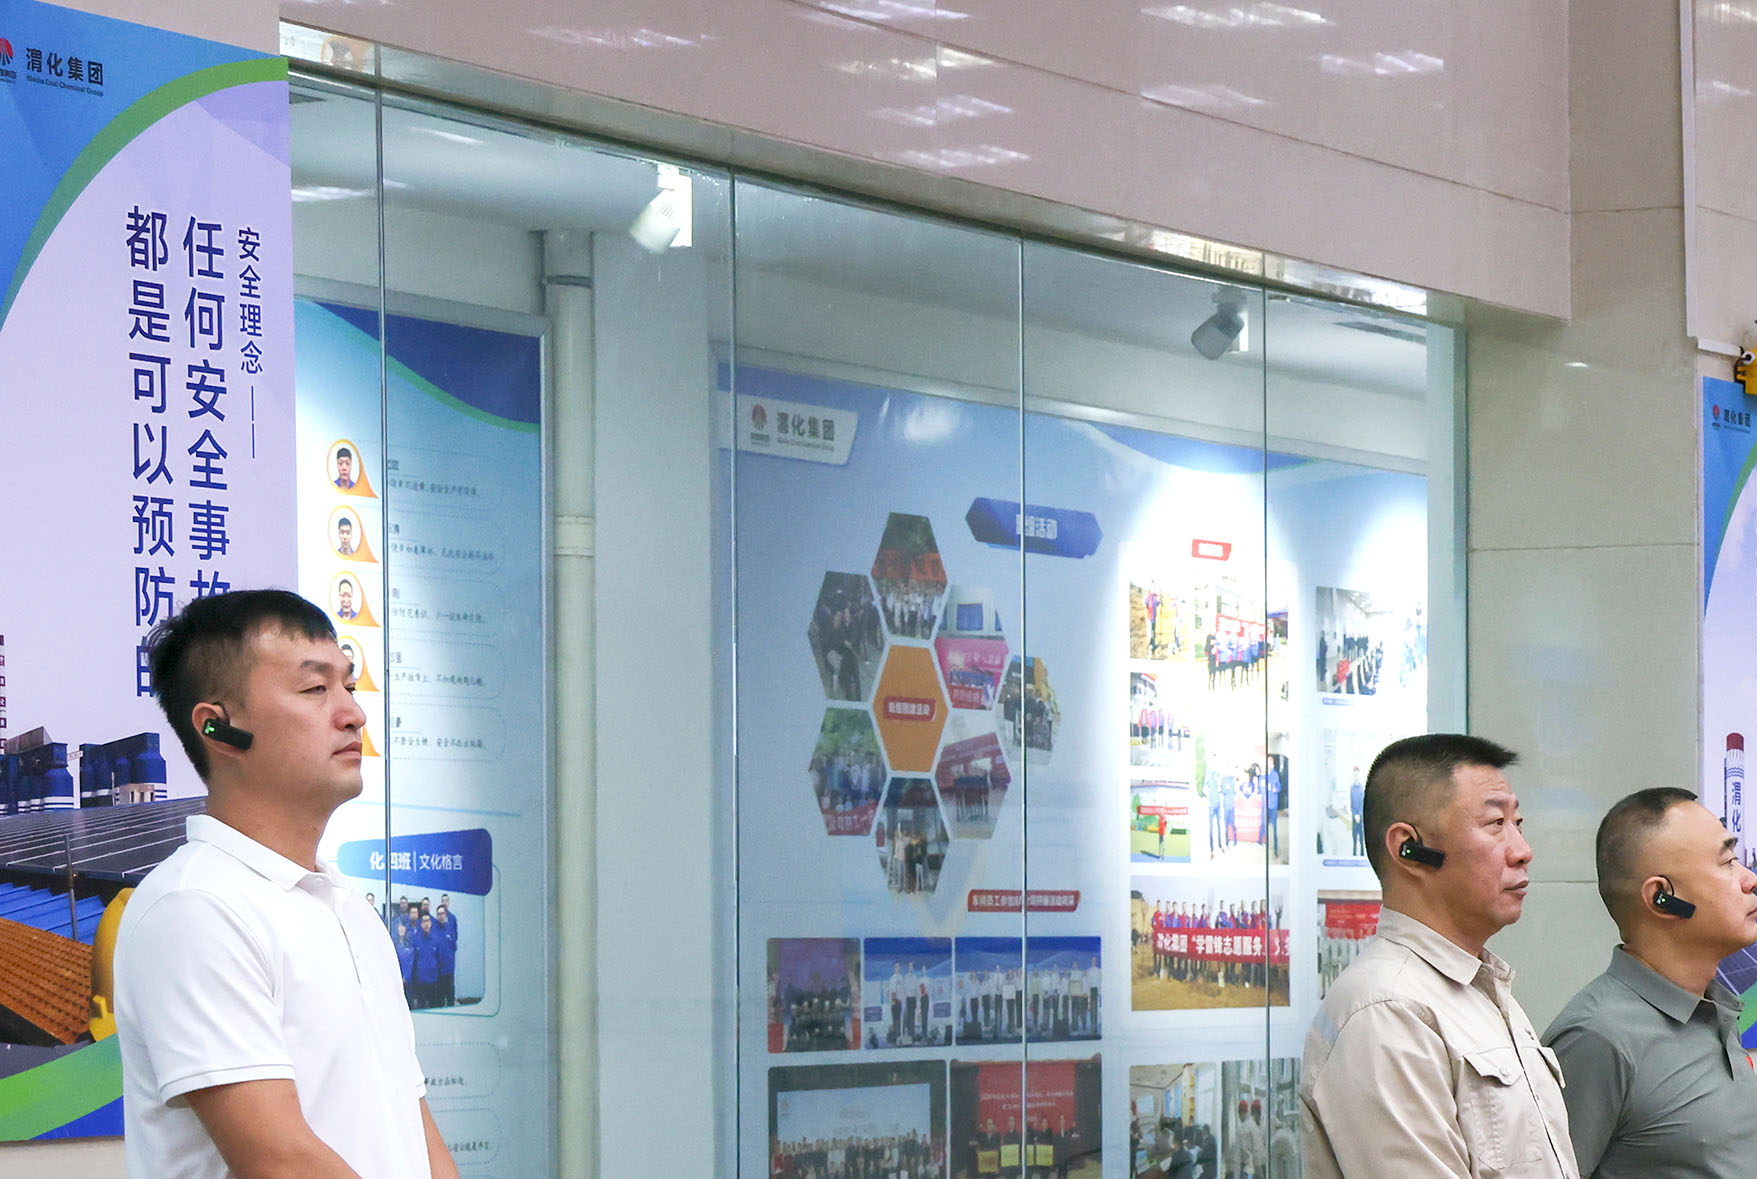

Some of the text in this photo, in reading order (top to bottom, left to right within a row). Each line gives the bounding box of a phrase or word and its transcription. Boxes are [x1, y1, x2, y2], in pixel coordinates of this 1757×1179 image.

[26, 47, 104, 86] 渭化集团
[419, 852, 463, 871] 文化格言
